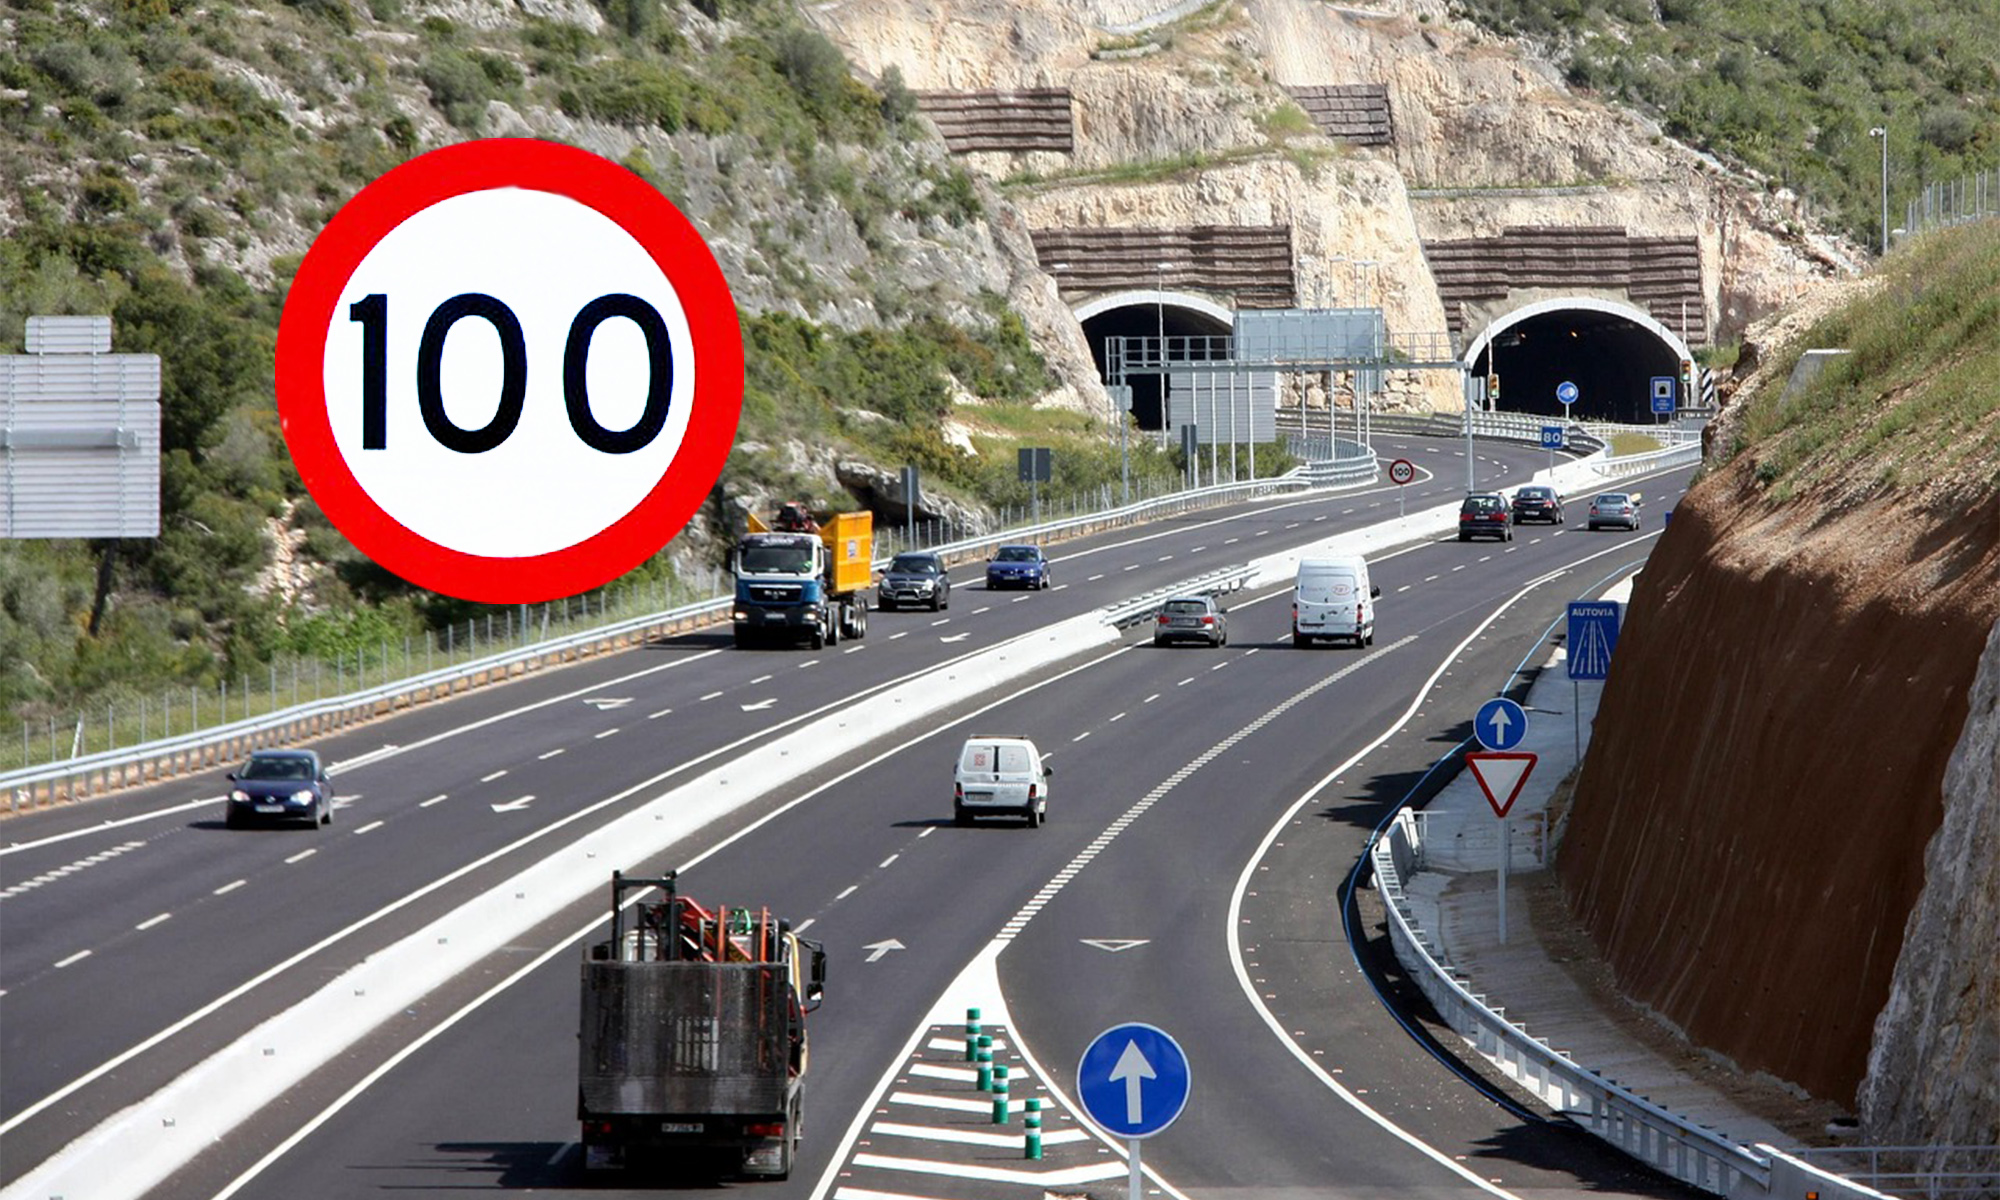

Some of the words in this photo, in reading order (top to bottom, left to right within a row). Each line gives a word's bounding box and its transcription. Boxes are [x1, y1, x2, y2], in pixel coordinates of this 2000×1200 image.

[1543, 432, 1561, 443] 80
[1394, 467, 1410, 477] 100
[1571, 608, 1615, 617] AUTOVIA
